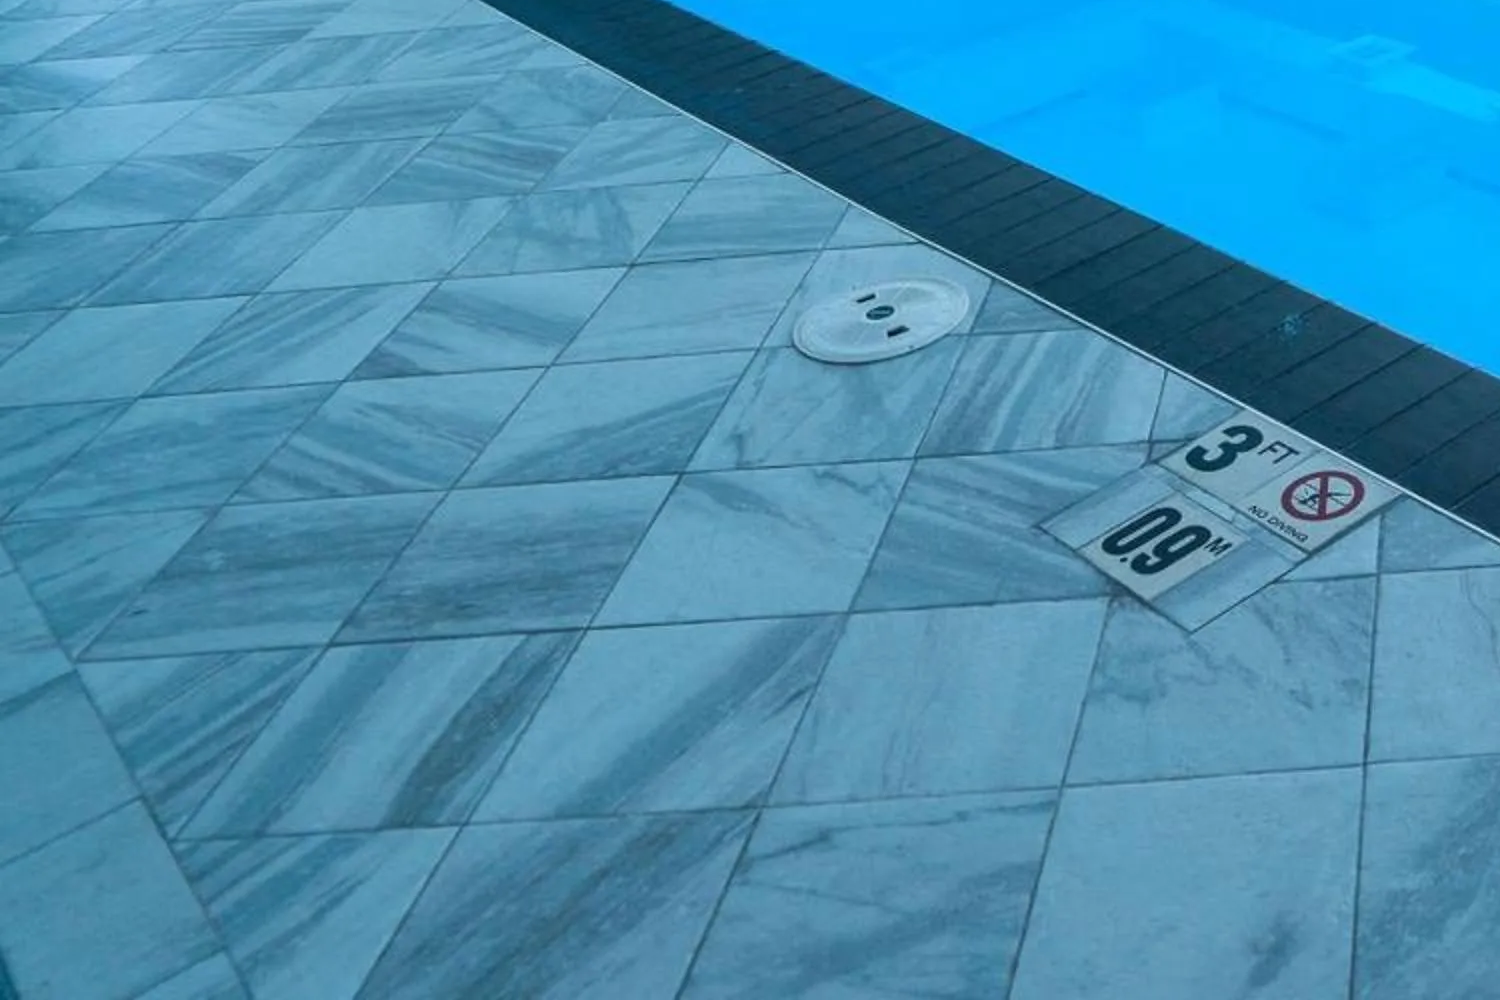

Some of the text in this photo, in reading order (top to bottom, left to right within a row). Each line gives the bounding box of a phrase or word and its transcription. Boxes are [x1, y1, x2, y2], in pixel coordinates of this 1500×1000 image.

[1185, 424, 1300, 472] 3 FT
[1101, 507, 1233, 575] 0.9 M
[1248, 505, 1309, 542] NO DIVING
